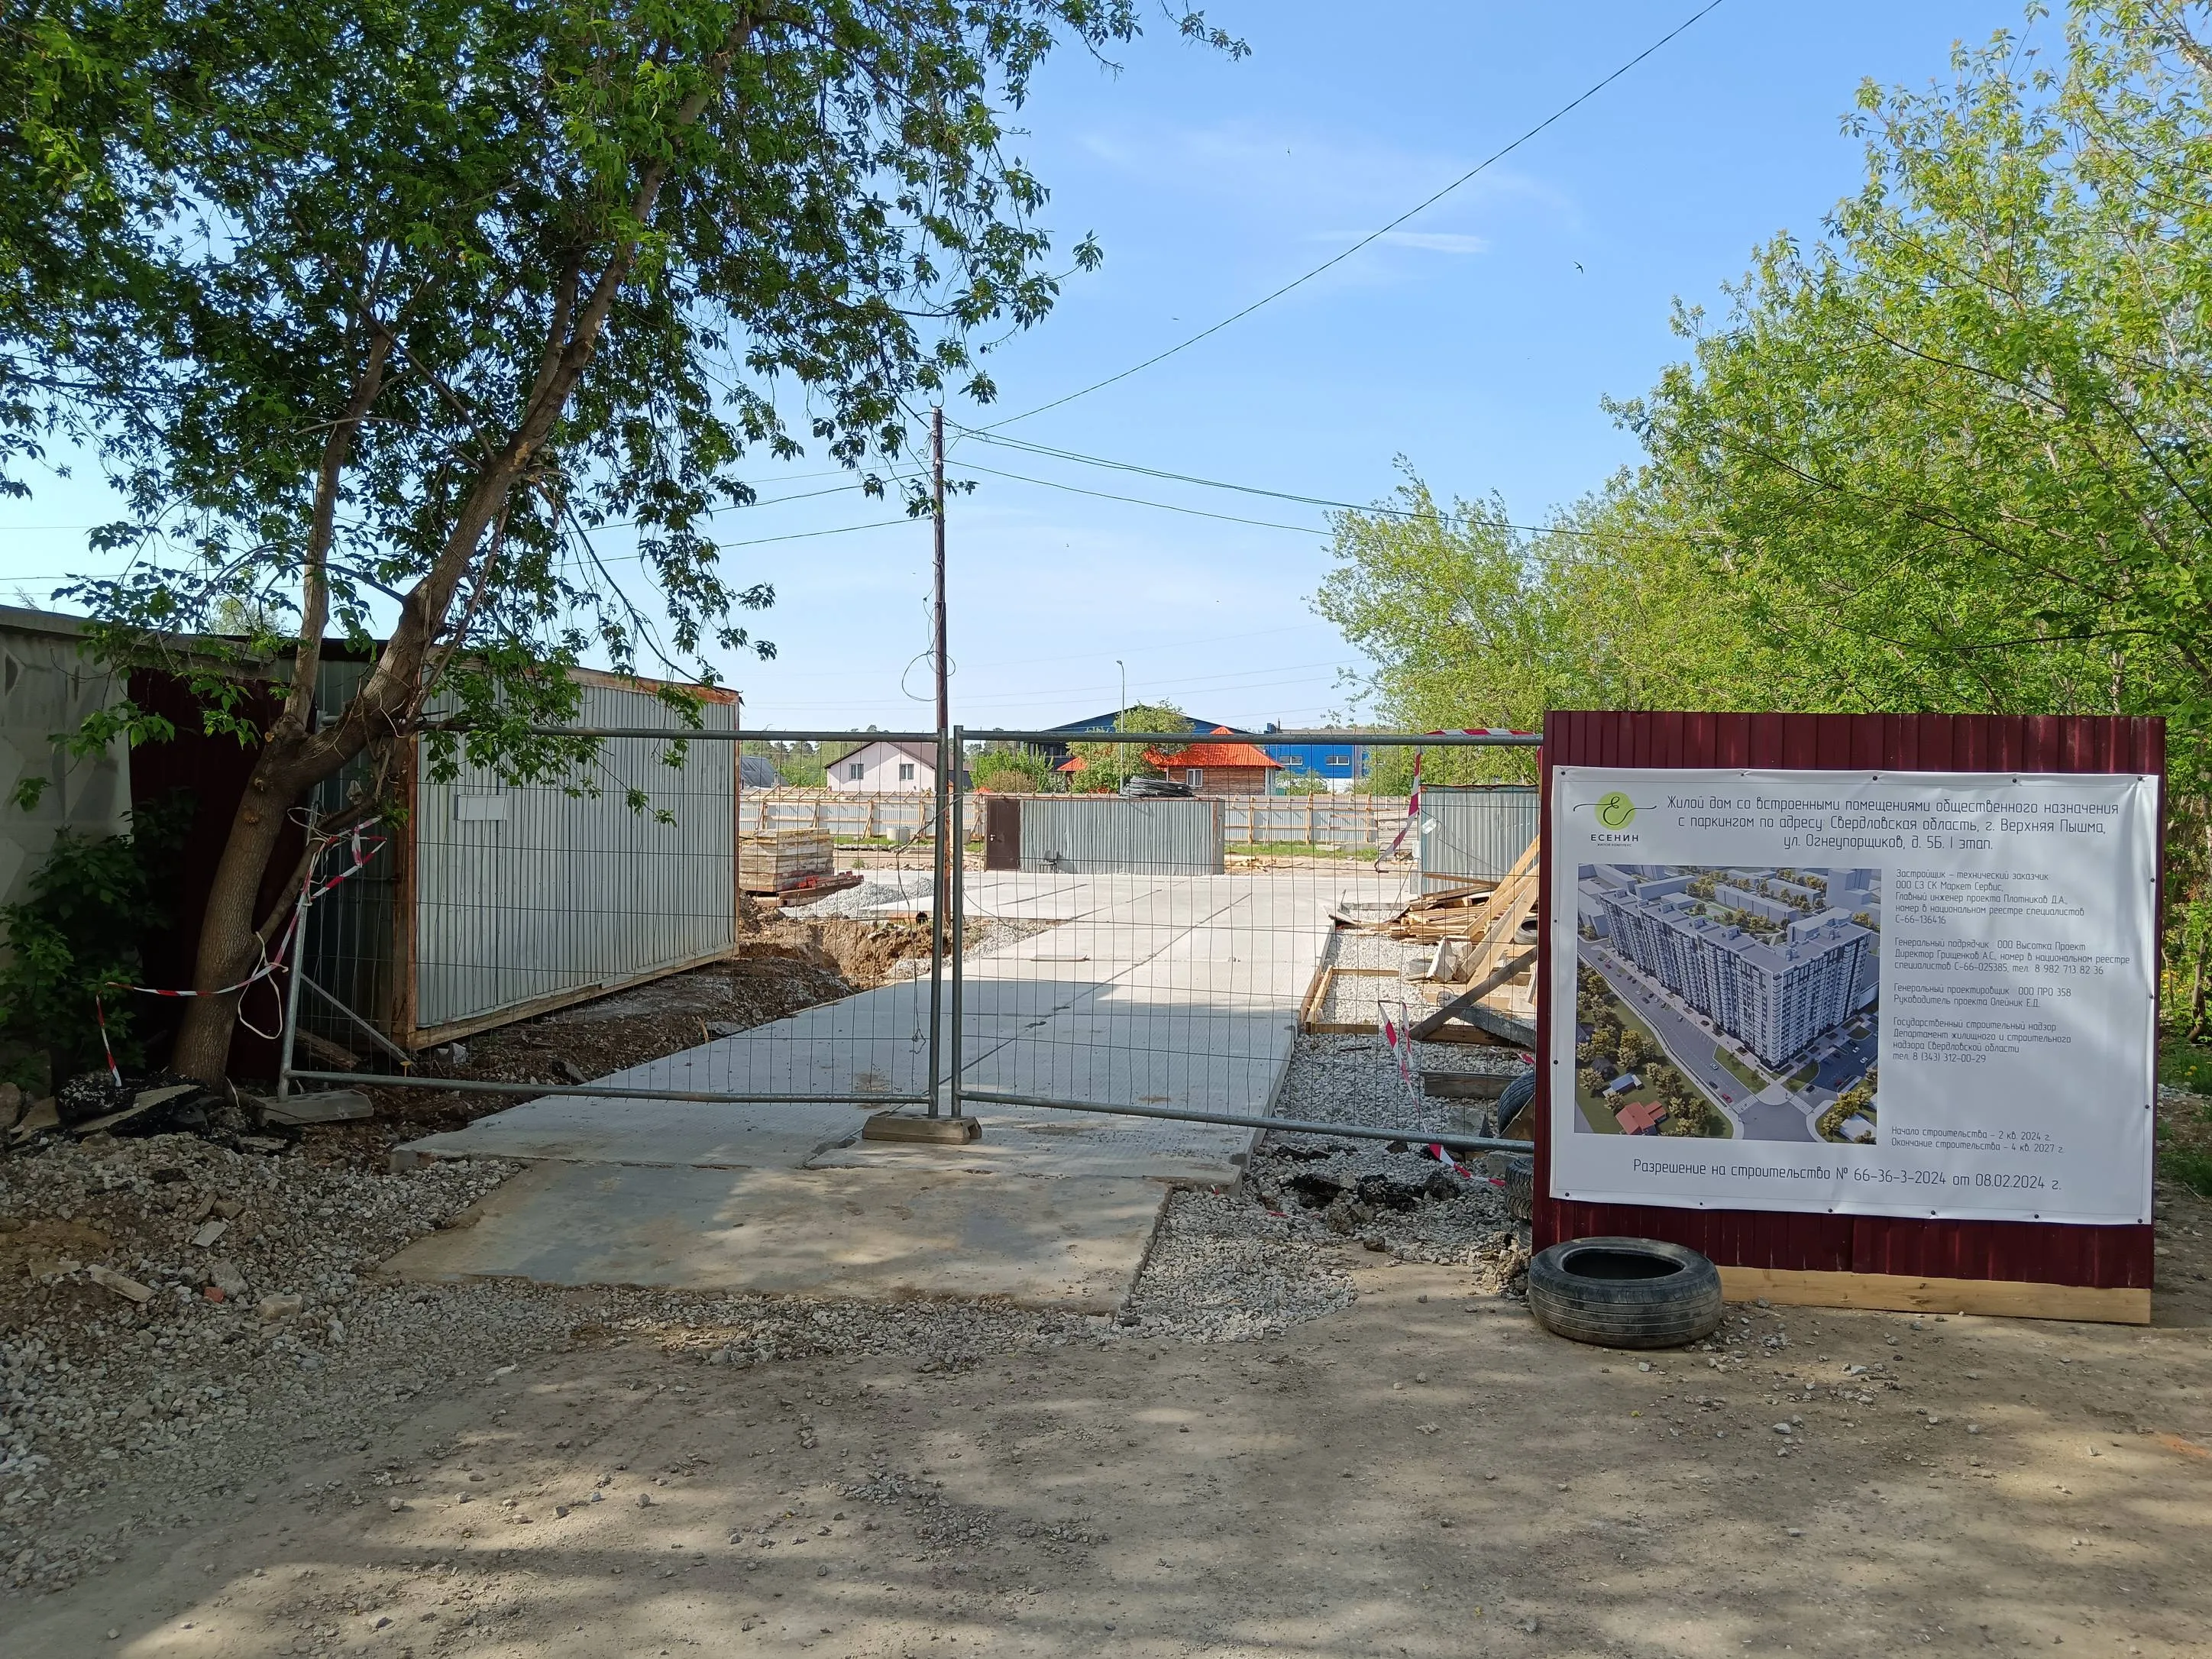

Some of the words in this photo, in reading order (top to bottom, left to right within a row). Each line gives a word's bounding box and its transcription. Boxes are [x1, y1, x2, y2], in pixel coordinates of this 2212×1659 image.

[1667, 795, 1704, 808] Жилой
[1709, 796, 1731, 809] дом
[1737, 800, 1751, 810] со
[1757, 797, 1840, 812] встроенными
[1845, 800, 1930, 812] помещениями
[1936, 799, 2038, 813] общественного
[2044, 803, 2119, 814] назначения
[1678, 817, 1685, 826] с
[1691, 817, 1754, 830] паркингом
[1760, 817, 1774, 827] по
[1831, 816, 1917, 831] Свердловская
[1923, 817, 1979, 832] область,
[1986, 821, 1995, 831] г.
[2001, 819, 2054, 834] Верхняя
[2060, 820, 2106, 834] Пышма,
[1784, 836, 1800, 849] ул.
[1806, 834, 1905, 849] Огнеупорщиков,
[1912, 836, 1921, 848] д.
[1958, 839, 1993, 849] этап.
[1897, 869, 1945, 879] Застройщик
[1957, 871, 2009, 879] технический
[1940, 882, 1971, 891] Маркет
[1974, 883, 2003, 892] Сервис,
[1896, 892, 1927, 901] Главный
[1967, 895, 2000, 904] проекта
[2004, 894, 2047, 904] Плотников
[1930, 906, 1986, 914] национальном
[2026, 907, 2084, 917] специалистов
[1895, 938, 1945, 949] Генеральный
[1948, 939, 1989, 949] подрядчик
[2016, 941, 2052, 950] Высотка
[2055, 942, 2085, 952] Проект
[1895, 949, 1934, 959] Директор
[1937, 950, 1979, 960] Грищенков
[2000, 953, 2023, 962] номер
[2028, 952, 2033, 961] в
[2036, 955, 2092, 963] национальном
[2096, 956, 2130, 965] реестре
[1895, 961, 1951, 971] специалистов
[2035, 965, 2040, 973] 8
[2043, 965, 2058, 973] 982
[2063, 965, 2076, 974] 713
[2080, 965, 2090, 974] 82
[2094, 966, 2104, 975] 36
[1894, 984, 1944, 994] Генеральный
[1947, 986, 2010, 995] проектировщик
[2018, 987, 2034, 995] ООО
[2037, 988, 2053, 996] ПРО
[2057, 988, 2071, 996] 358
[1894, 994, 1951, 1005] Руководитель
[1954, 998, 1987, 1007] проекта
[1990, 997, 2023, 1007] Олейник
[1894, 1017, 1963, 1027] Государственный
[1966, 1020, 2025, 1030] строительный
[2029, 1022, 2055, 1030] надзор
[1894, 1029, 1948, 1039] Департамент
[2007, 1034, 2071, 1043] строительного
[1893, 1040, 1924, 1049] надзора
[1928, 1042, 1981, 1052] Свердловской
[1985, 1044, 2019, 1053] области
[1921, 1053, 1939, 1062] (343)
[1892, 1127, 1919, 1135] Начало
[1923, 1129, 1987, 1138] строительства
[2021, 1132, 2041, 1140] 2024
[1892, 1137, 1932, 1147] Окончание
[1936, 1140, 2000, 1150] строительства
[1634, 1159, 1706, 1175] Разрешение
[1712, 1164, 1726, 1175] на
[1731, 1163, 1831, 1180] строительство
[1952, 1174, 1970, 1185] от
[1975, 1172, 2045, 1188] 08.02.2024
[2051, 1179, 2062, 1190] г.
